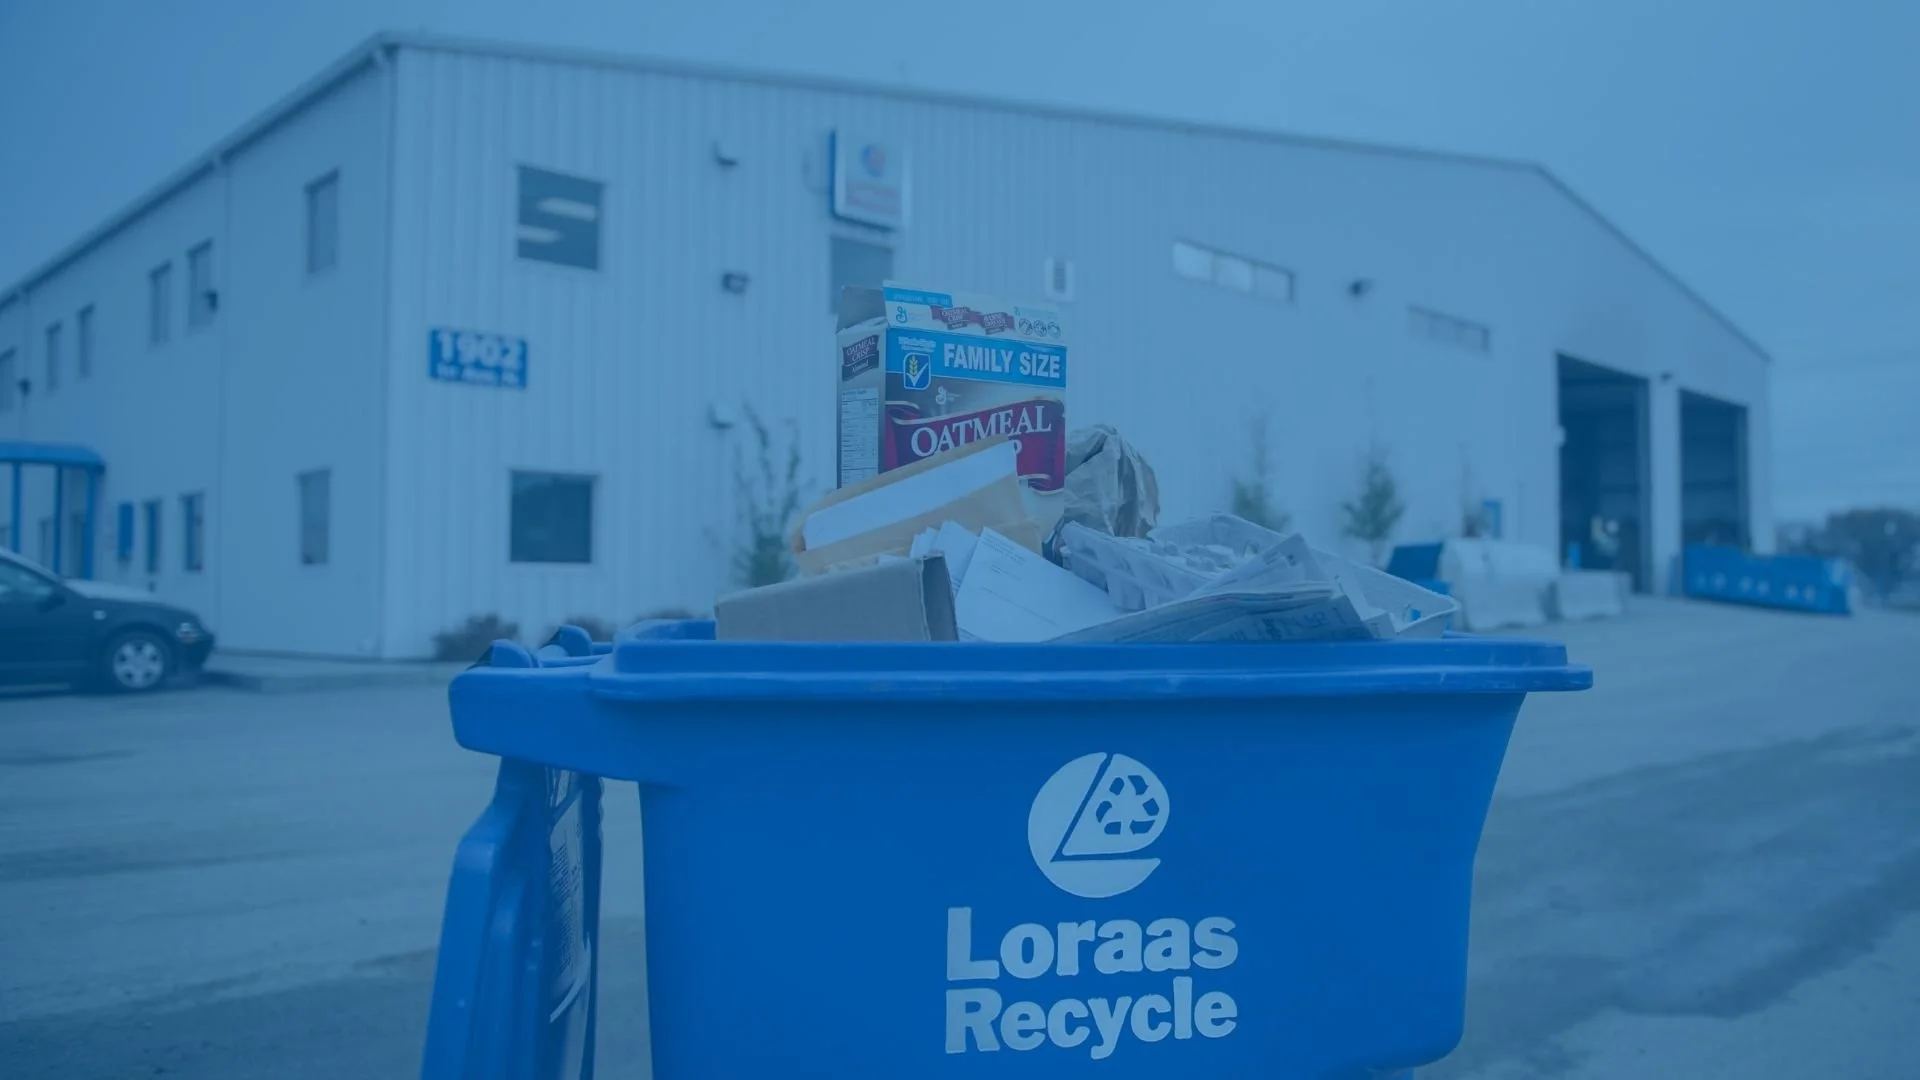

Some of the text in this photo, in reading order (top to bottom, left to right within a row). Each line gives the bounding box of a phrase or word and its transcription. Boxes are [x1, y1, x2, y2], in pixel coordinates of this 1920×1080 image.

[438, 331, 519, 369] 1902
[943, 342, 1015, 374] FAMILY
[1019, 351, 1061, 379] SIZE
[910, 405, 1052, 457] OATMEAL
[946, 906, 1239, 981] Loraas
[945, 975, 1238, 1060] Recycle
